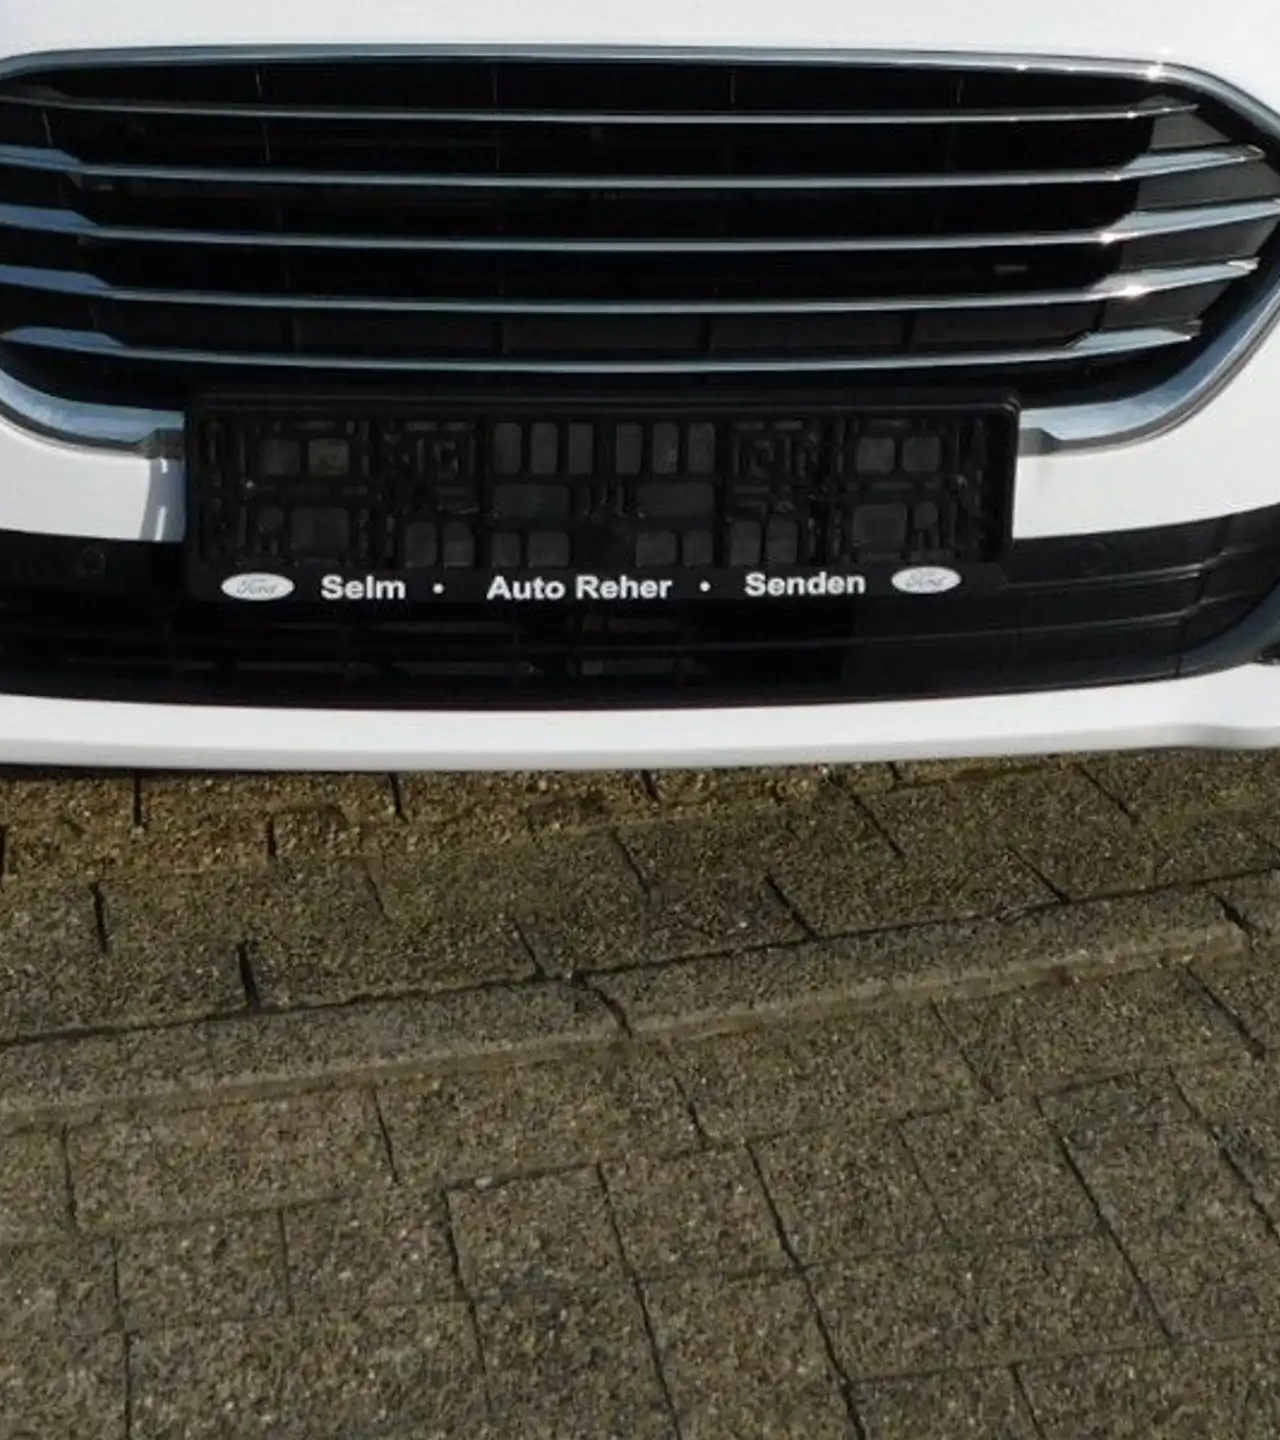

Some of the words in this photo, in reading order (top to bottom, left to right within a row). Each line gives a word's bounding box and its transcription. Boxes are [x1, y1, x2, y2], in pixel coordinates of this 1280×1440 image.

[320, 573, 407, 600] Selm
[486, 574, 566, 601] Auto
[575, 574, 674, 600] Reher
[744, 570, 866, 598] Senden
